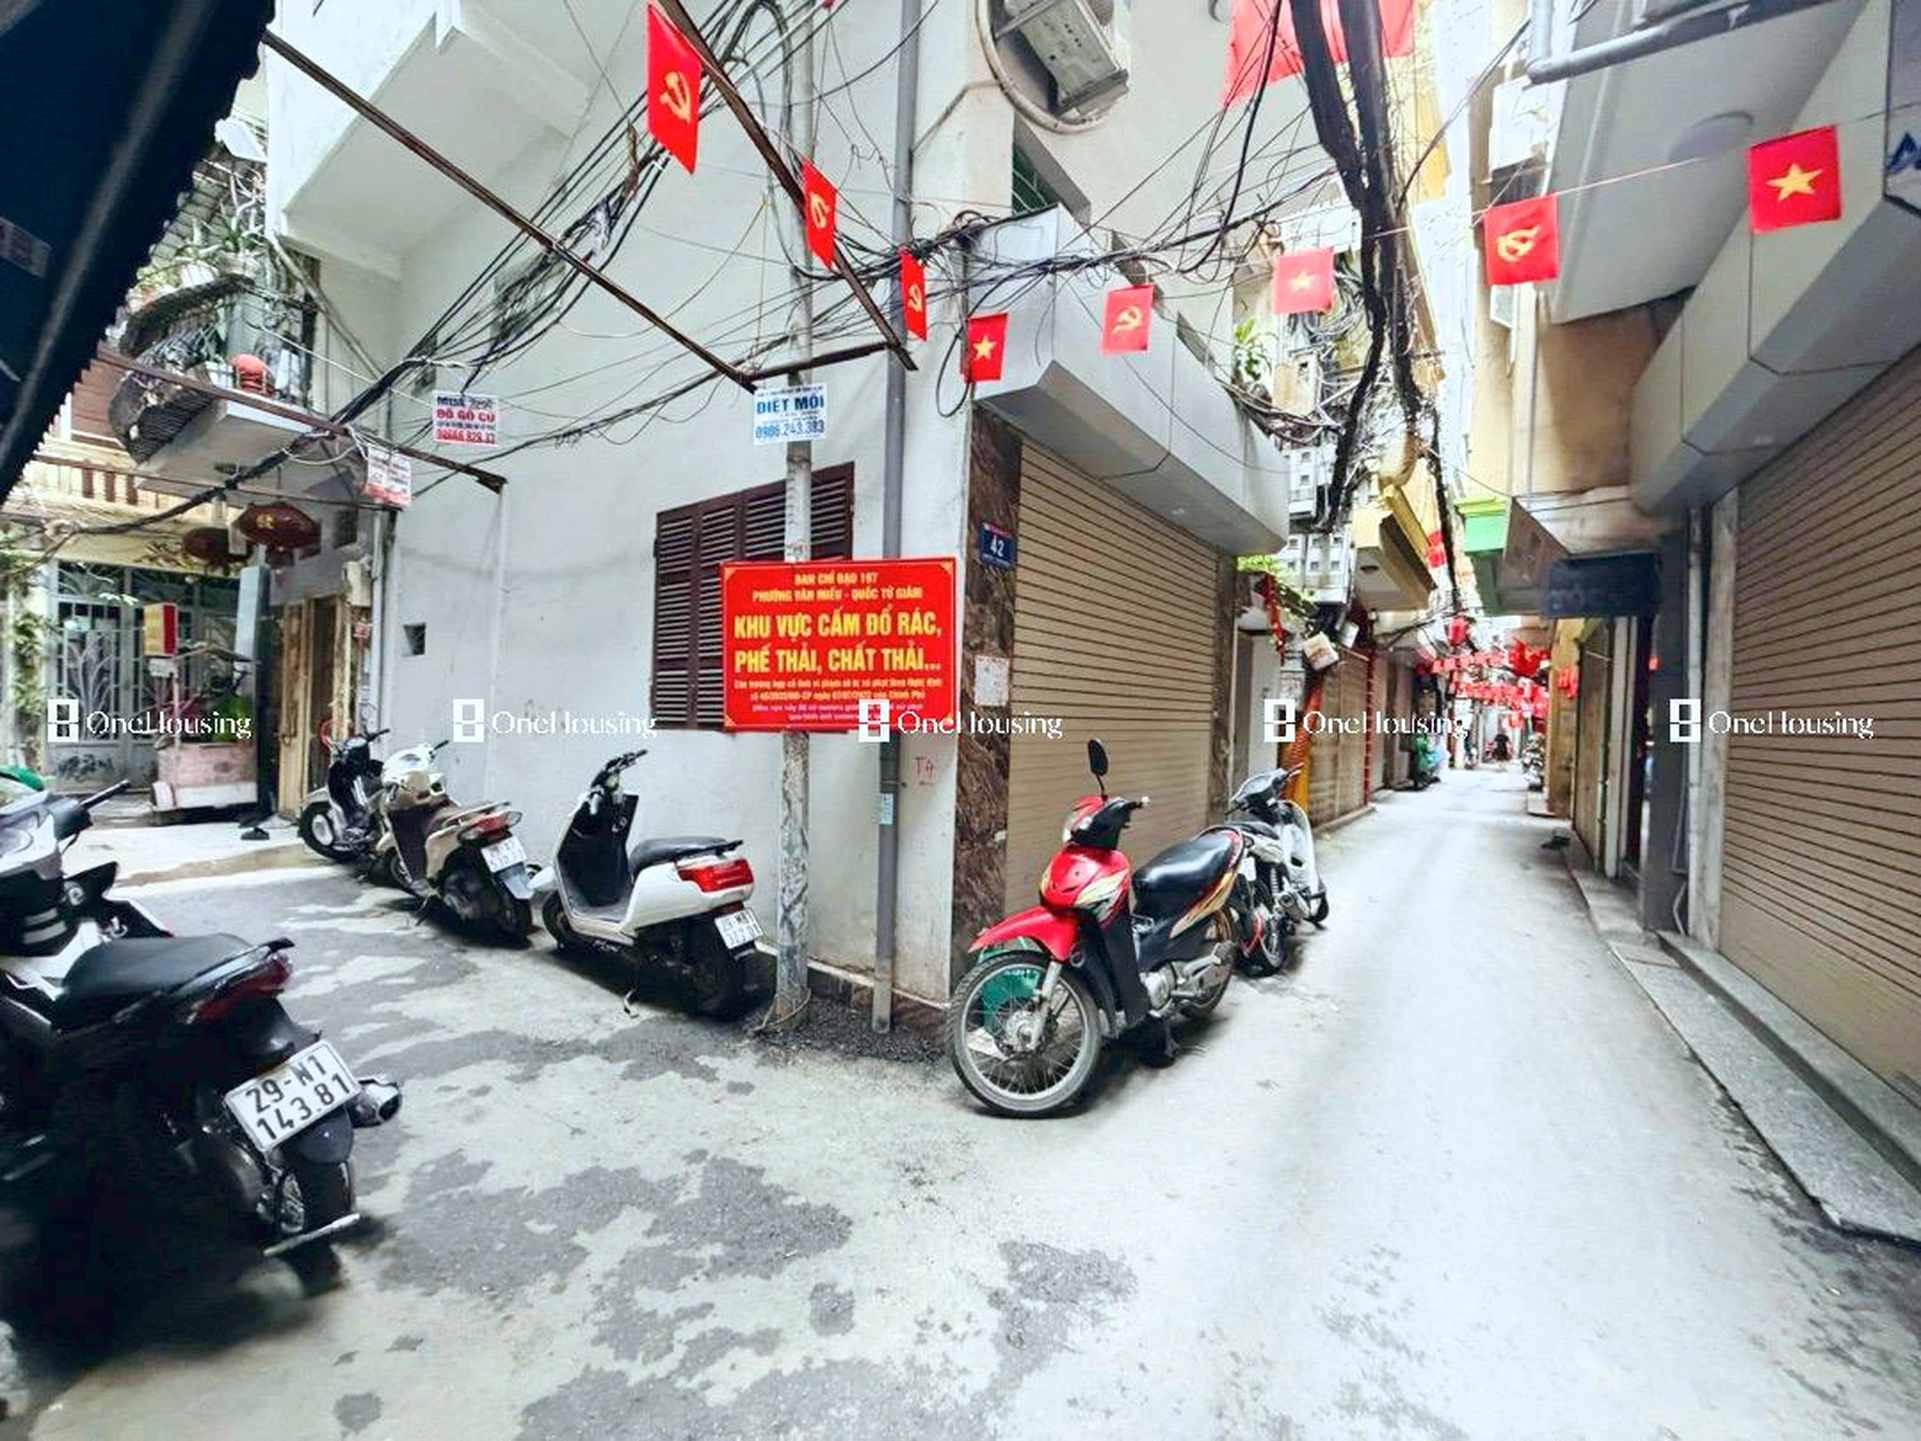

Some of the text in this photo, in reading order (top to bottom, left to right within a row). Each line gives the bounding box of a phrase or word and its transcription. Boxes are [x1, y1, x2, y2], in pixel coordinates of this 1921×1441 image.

[990, 534, 1005, 557] 42
[851, 586, 879, 602] QUỐC
[895, 584, 923, 599] GIÁM
[733, 603, 943, 643] KHU VỰC CẤM ĐỔ RÁC,
[734, 640, 941, 675] PHẾ THẢI, CHẤT THẢI...
[245, 1055, 326, 1114] 29-N1
[257, 1073, 350, 1140] 143.81
